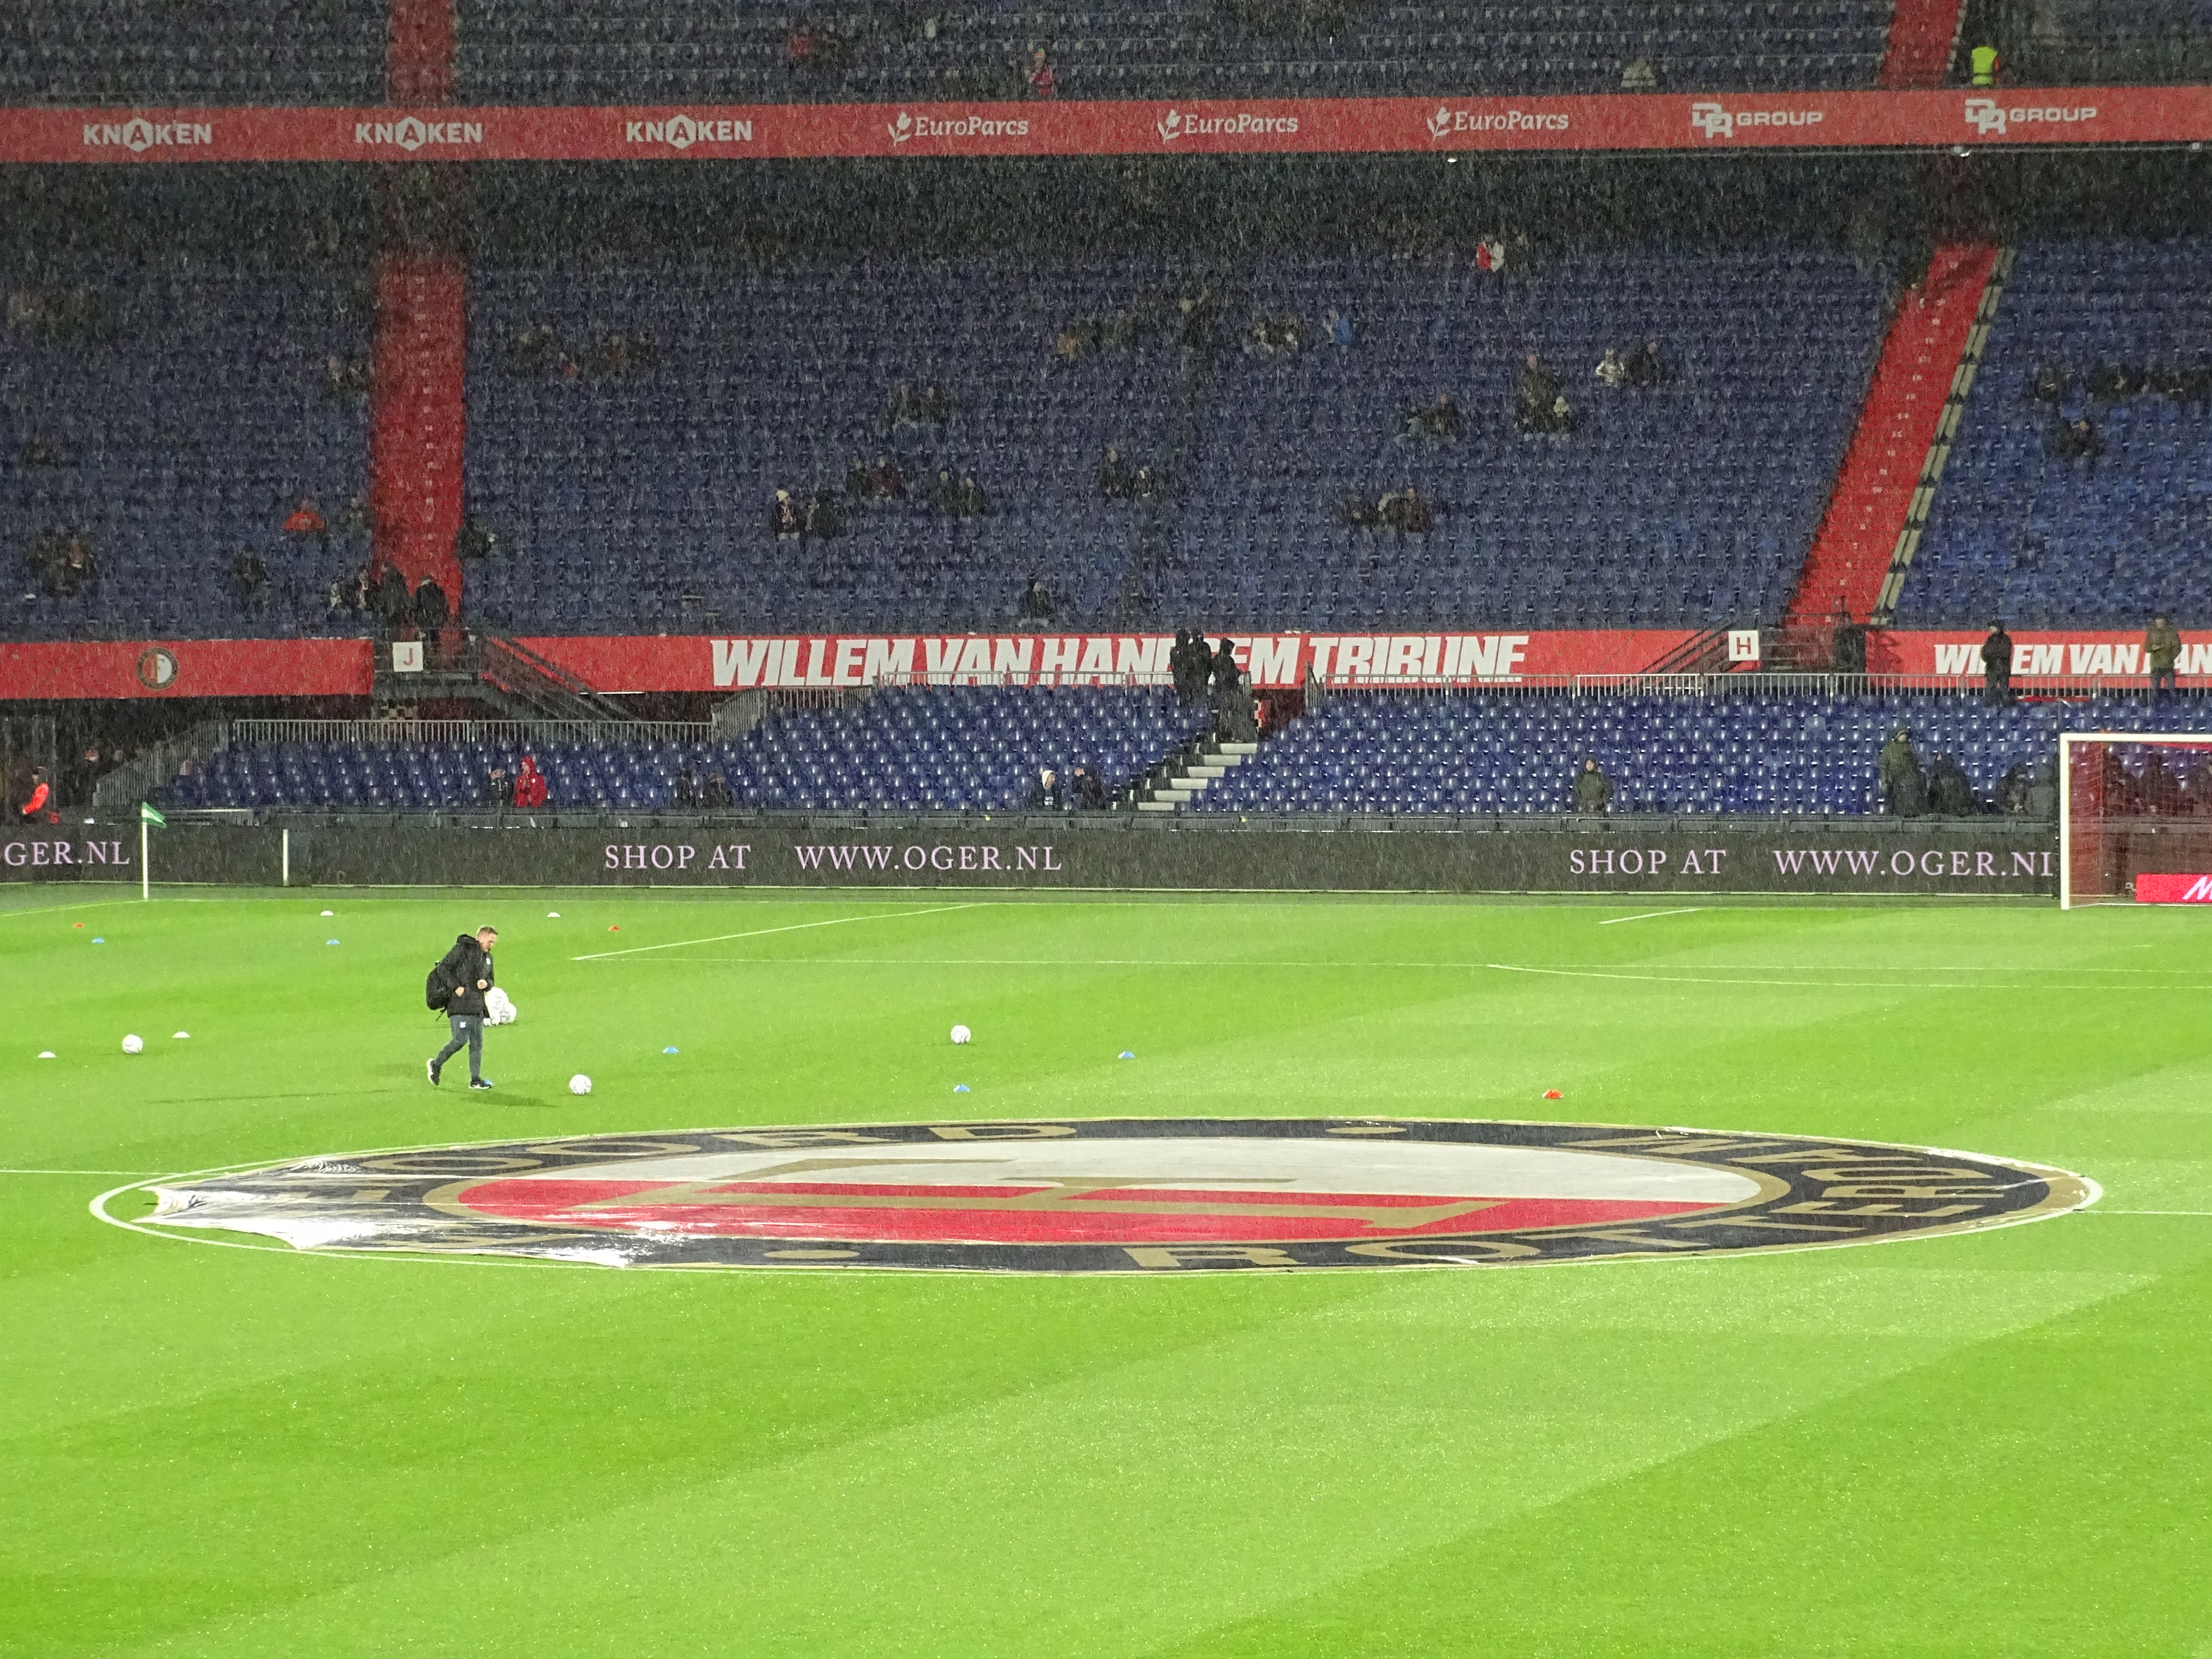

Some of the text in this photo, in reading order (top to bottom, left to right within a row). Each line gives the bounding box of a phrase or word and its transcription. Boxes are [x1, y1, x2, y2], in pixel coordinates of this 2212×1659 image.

[915, 116, 1029, 137] EuroParcs
[1184, 114, 1299, 134] EuroParcs
[1453, 110, 1569, 131] EuroParcs
[1735, 111, 1824, 127] GROUP
[2009, 107, 2098, 123] GROUP
[83, 117, 212, 152] KNAKEN
[355, 116, 483, 151] KNAKEN
[626, 114, 753, 149] KNAKEN
[403, 647, 413, 666] J
[1736, 637, 1751, 655] H
[710, 639, 916, 686] WILLEM
[923, 638, 1035, 686] VAN
[1308, 635, 1529, 684] TRIBUNE
[1933, 644, 2065, 675] WIEM
[2069, 644, 2140, 674] VAN
[4, 841, 130, 866] GER.NL
[605, 844, 1062, 870] SHOP AT WWW.OGER.NL
[1570, 850, 1667, 874] SHOP
[1680, 849, 1727, 874] AT
